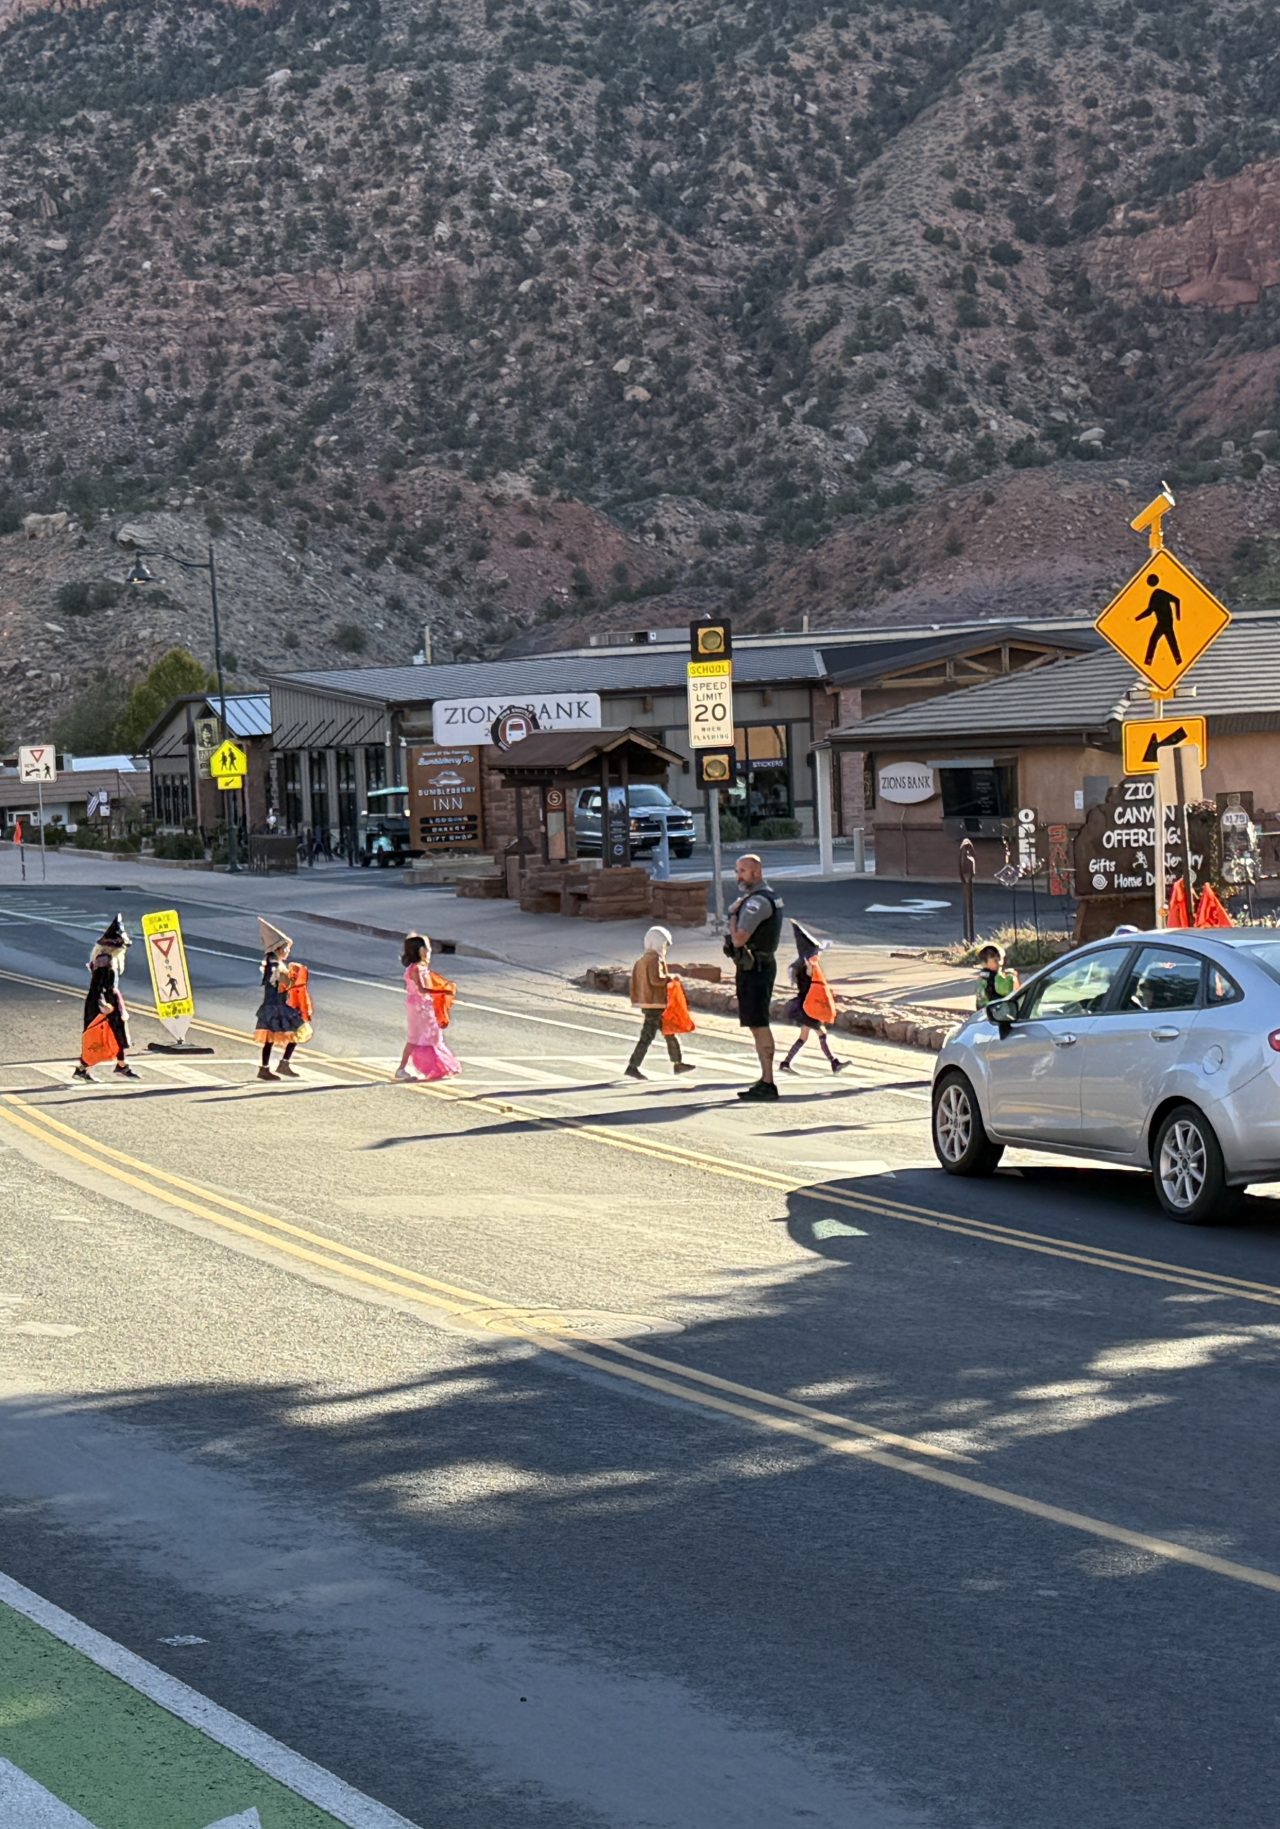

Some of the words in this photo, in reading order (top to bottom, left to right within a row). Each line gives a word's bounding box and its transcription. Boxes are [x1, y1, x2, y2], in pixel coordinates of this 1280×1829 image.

[690, 665, 727, 675] SCHOOL
[692, 681, 728, 692] SPEED
[696, 692, 724, 702] LIMIT
[444, 705, 514, 725] ZION
[694, 703, 727, 722] 20
[693, 733, 729, 741] FLASHING
[881, 777, 906, 790] ZIONS
[908, 776, 931, 789] BANK
[552, 793, 559, 802] 5
[1125, 782, 1155, 800] ZIO
[433, 797, 463, 811] INN
[1114, 805, 1175, 824] CANYN
[1102, 827, 1181, 848] OFFERIG
[1088, 859, 1116, 872] Gifts
[1163, 852, 1203, 870] Jelry
[1114, 874, 1142, 888] Home
[1146, 871, 1176, 886] Dor
